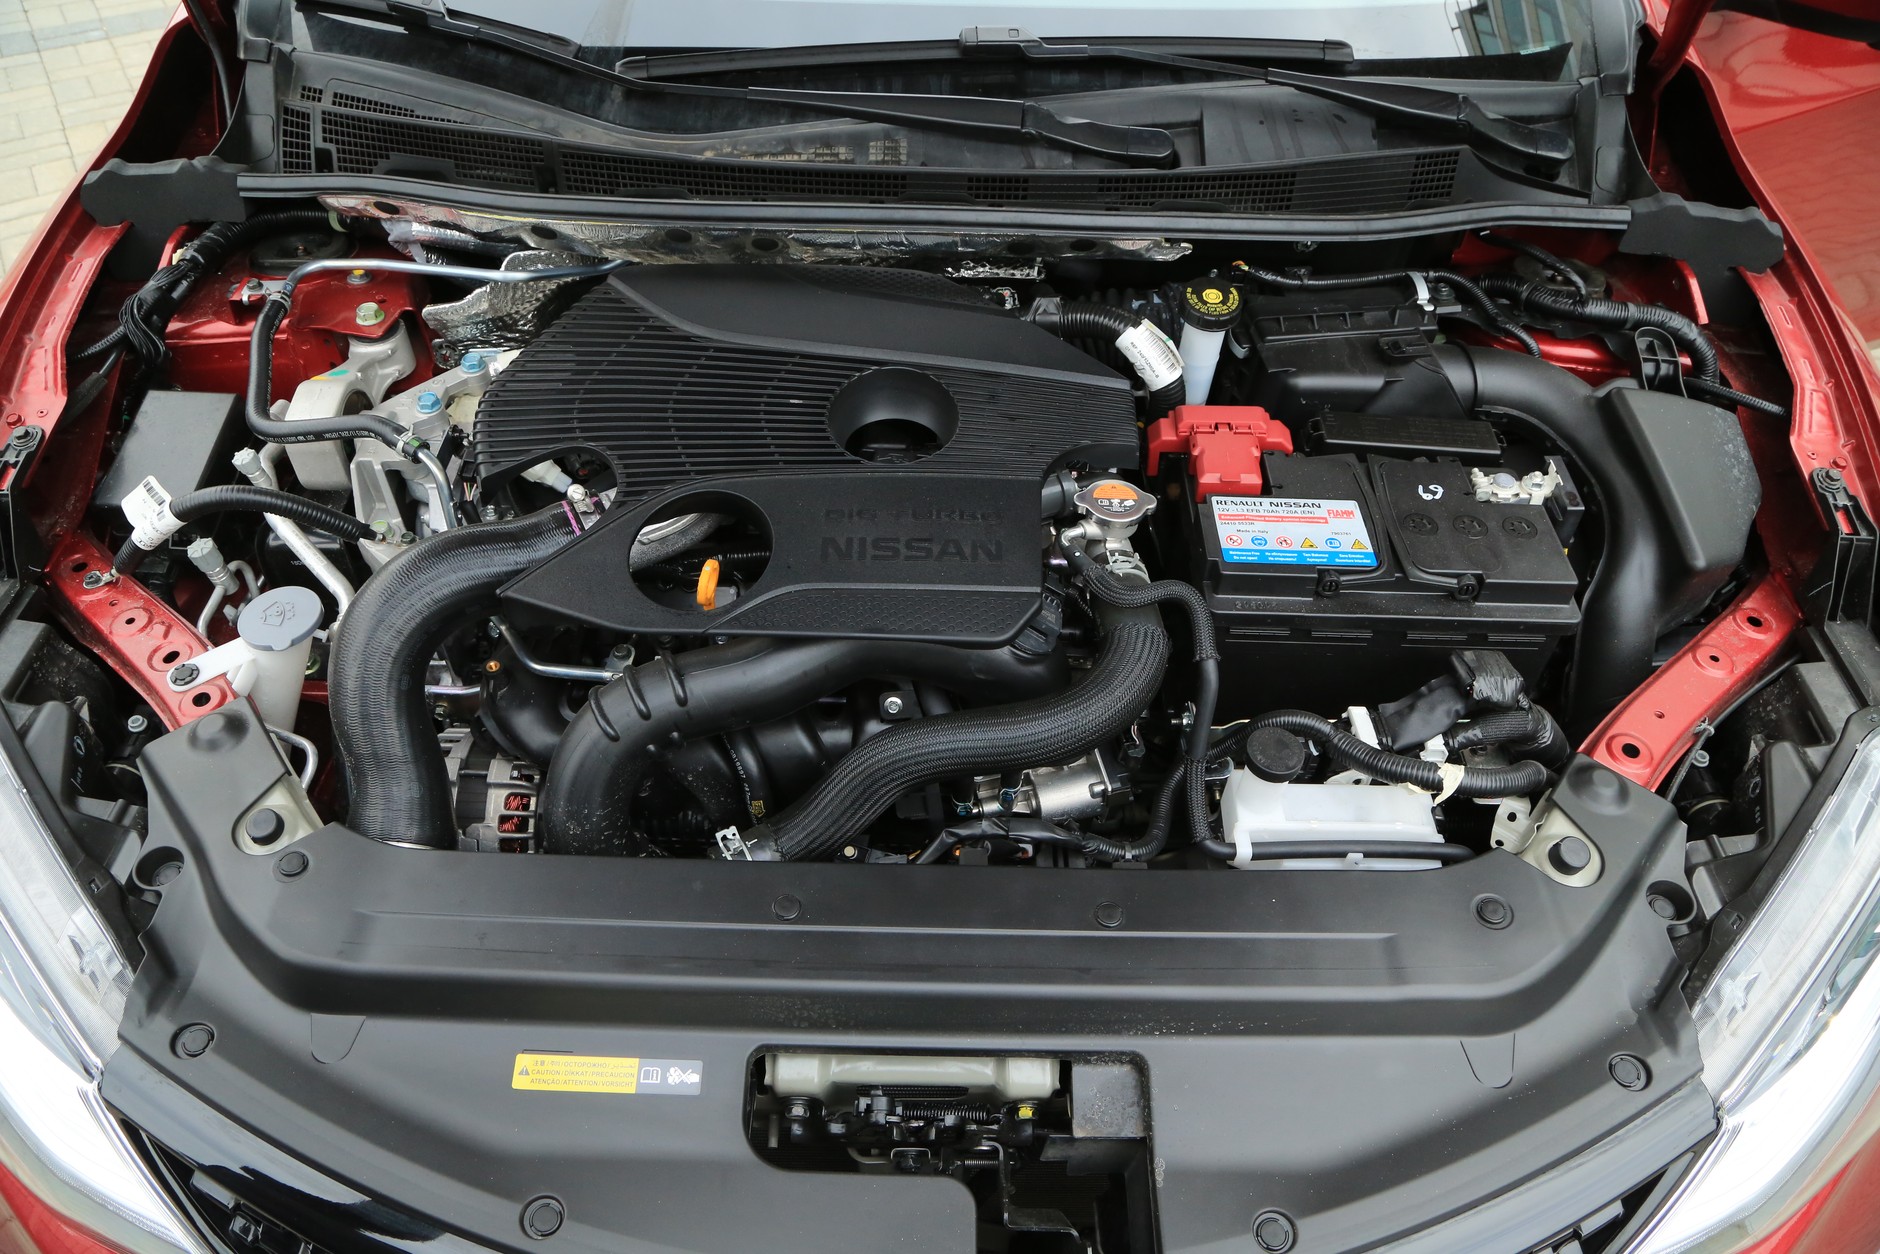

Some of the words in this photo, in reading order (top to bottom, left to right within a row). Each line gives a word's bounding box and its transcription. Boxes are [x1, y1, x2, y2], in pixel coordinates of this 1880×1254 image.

[1269, 501, 1321, 509] NISSAN
[1327, 509, 1355, 517] FIAMM
[820, 536, 1003, 562] NISSAN
